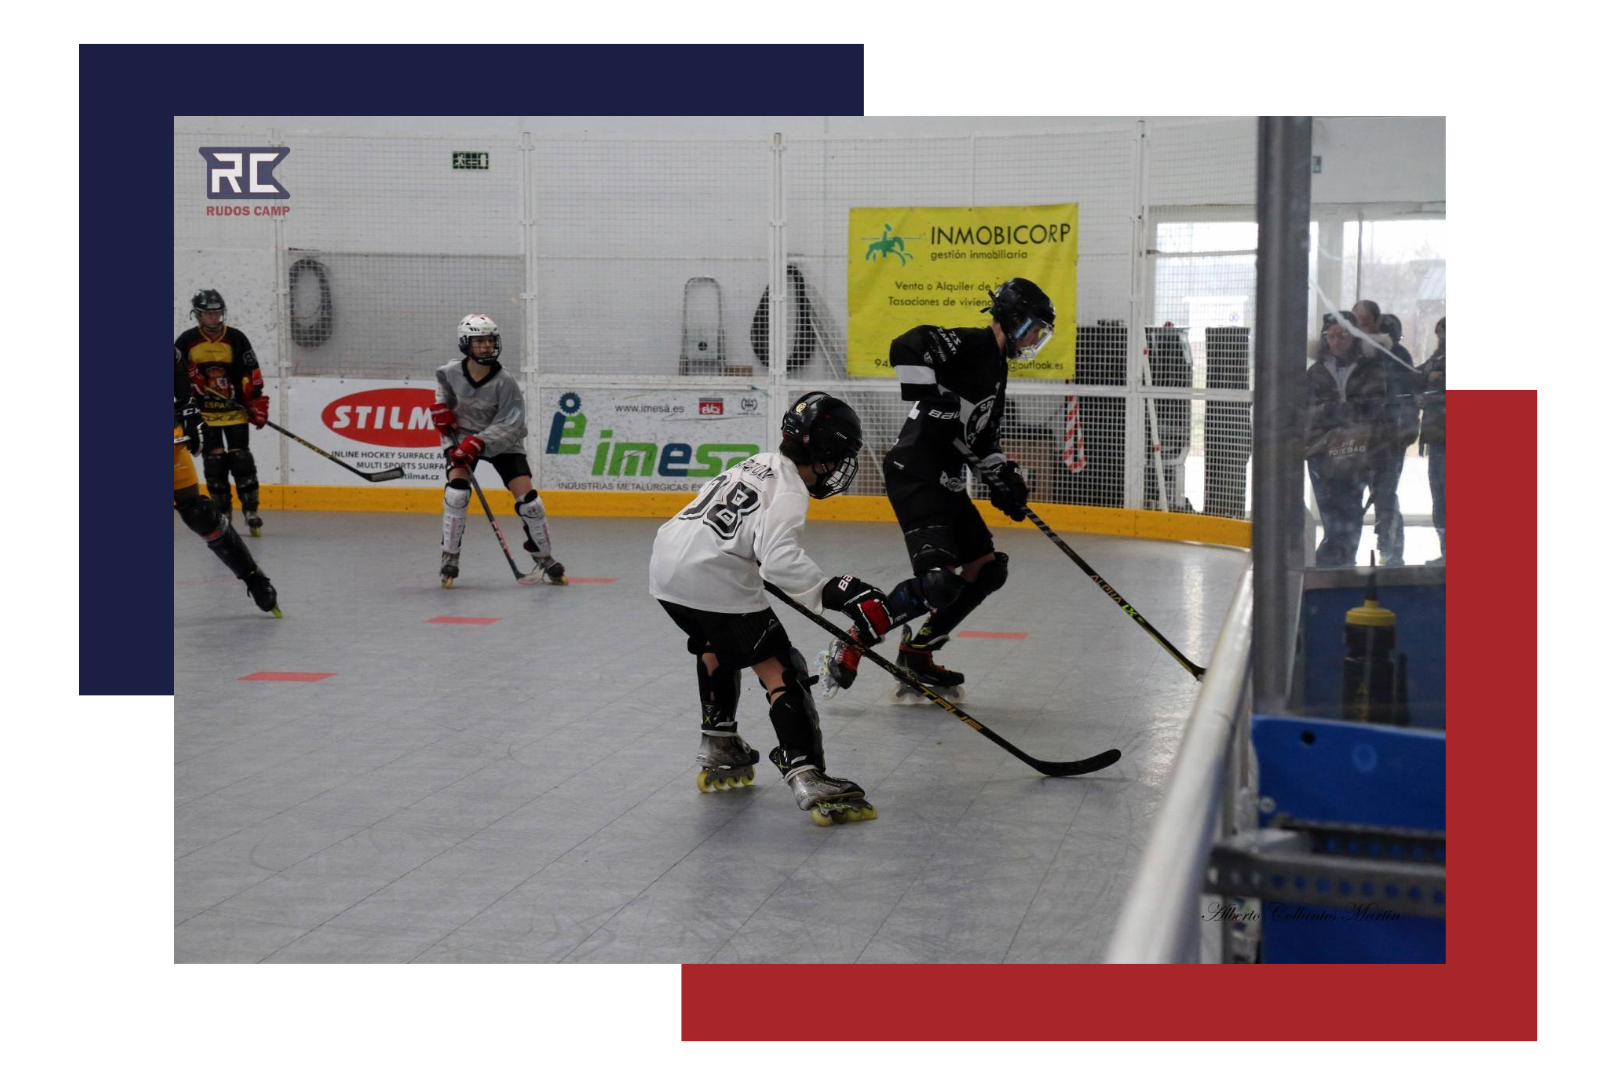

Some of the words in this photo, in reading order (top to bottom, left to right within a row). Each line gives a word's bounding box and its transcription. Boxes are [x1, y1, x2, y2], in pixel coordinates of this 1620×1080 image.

[930, 223, 1071, 246] INMOBICORP
[930, 249, 967, 261] gestión
[969, 249, 1028, 260] inmobiliaria
[895, 281, 924, 291] Venta
[926, 283, 934, 291] o
[936, 281, 975, 293] Alquiler
[978, 281, 991, 292] de
[888, 296, 940, 307] Tasaciones
[943, 296, 956, 307] de
[1007, 360, 1065, 372] @outlook.es
[614, 403, 685, 413] www.imesa.es
[332, 405, 436, 430] STILM
[331, 451, 359, 459] INLINE
[361, 451, 396, 459] HOCKEY
[397, 452, 434, 460] SURFACE
[384, 462, 416, 470] SPORTS
[402, 473, 440, 481] tilmat.cz
[558, 482, 614, 491] INDUSTRIAS
